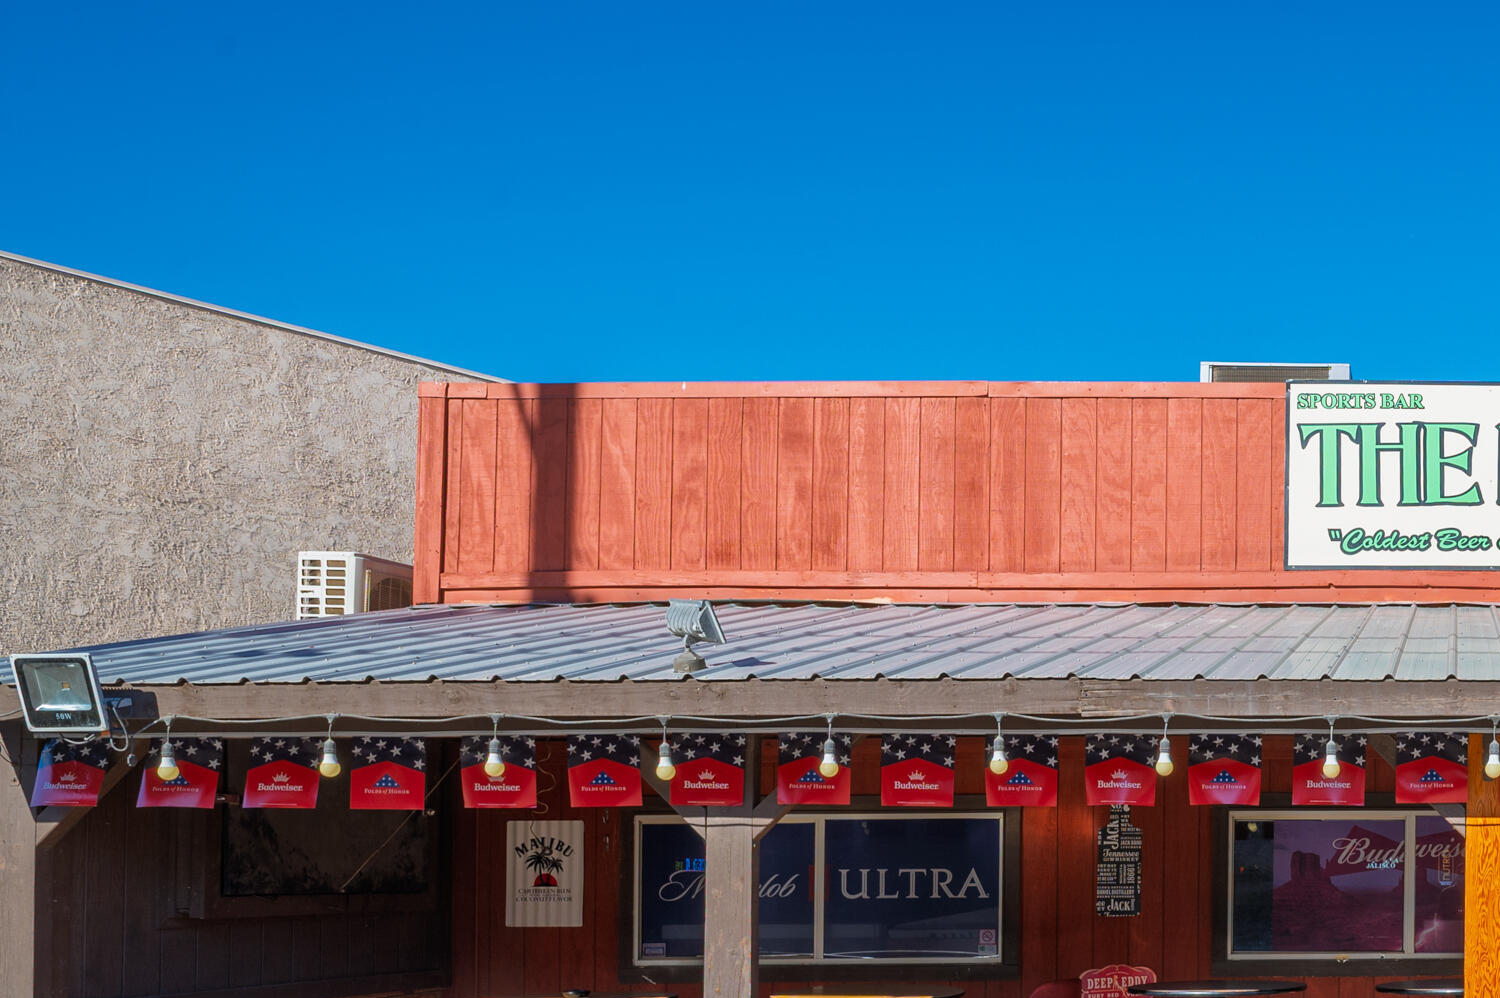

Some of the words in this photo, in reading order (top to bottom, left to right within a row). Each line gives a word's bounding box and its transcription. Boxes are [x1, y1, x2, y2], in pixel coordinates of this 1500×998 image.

[1297, 393, 1376, 409] SPORTS
[1380, 394, 1425, 409] BAR
[1297, 421, 1484, 507] THE
[1434, 529, 1492, 551] Beer
[1103, 821, 1119, 850] JACK
[1103, 849, 1139, 857] Tennessee
[840, 868, 989, 899] ULTRA
[1087, 977, 1112, 989] DEEP
[1121, 976, 1148, 987] EDDY
